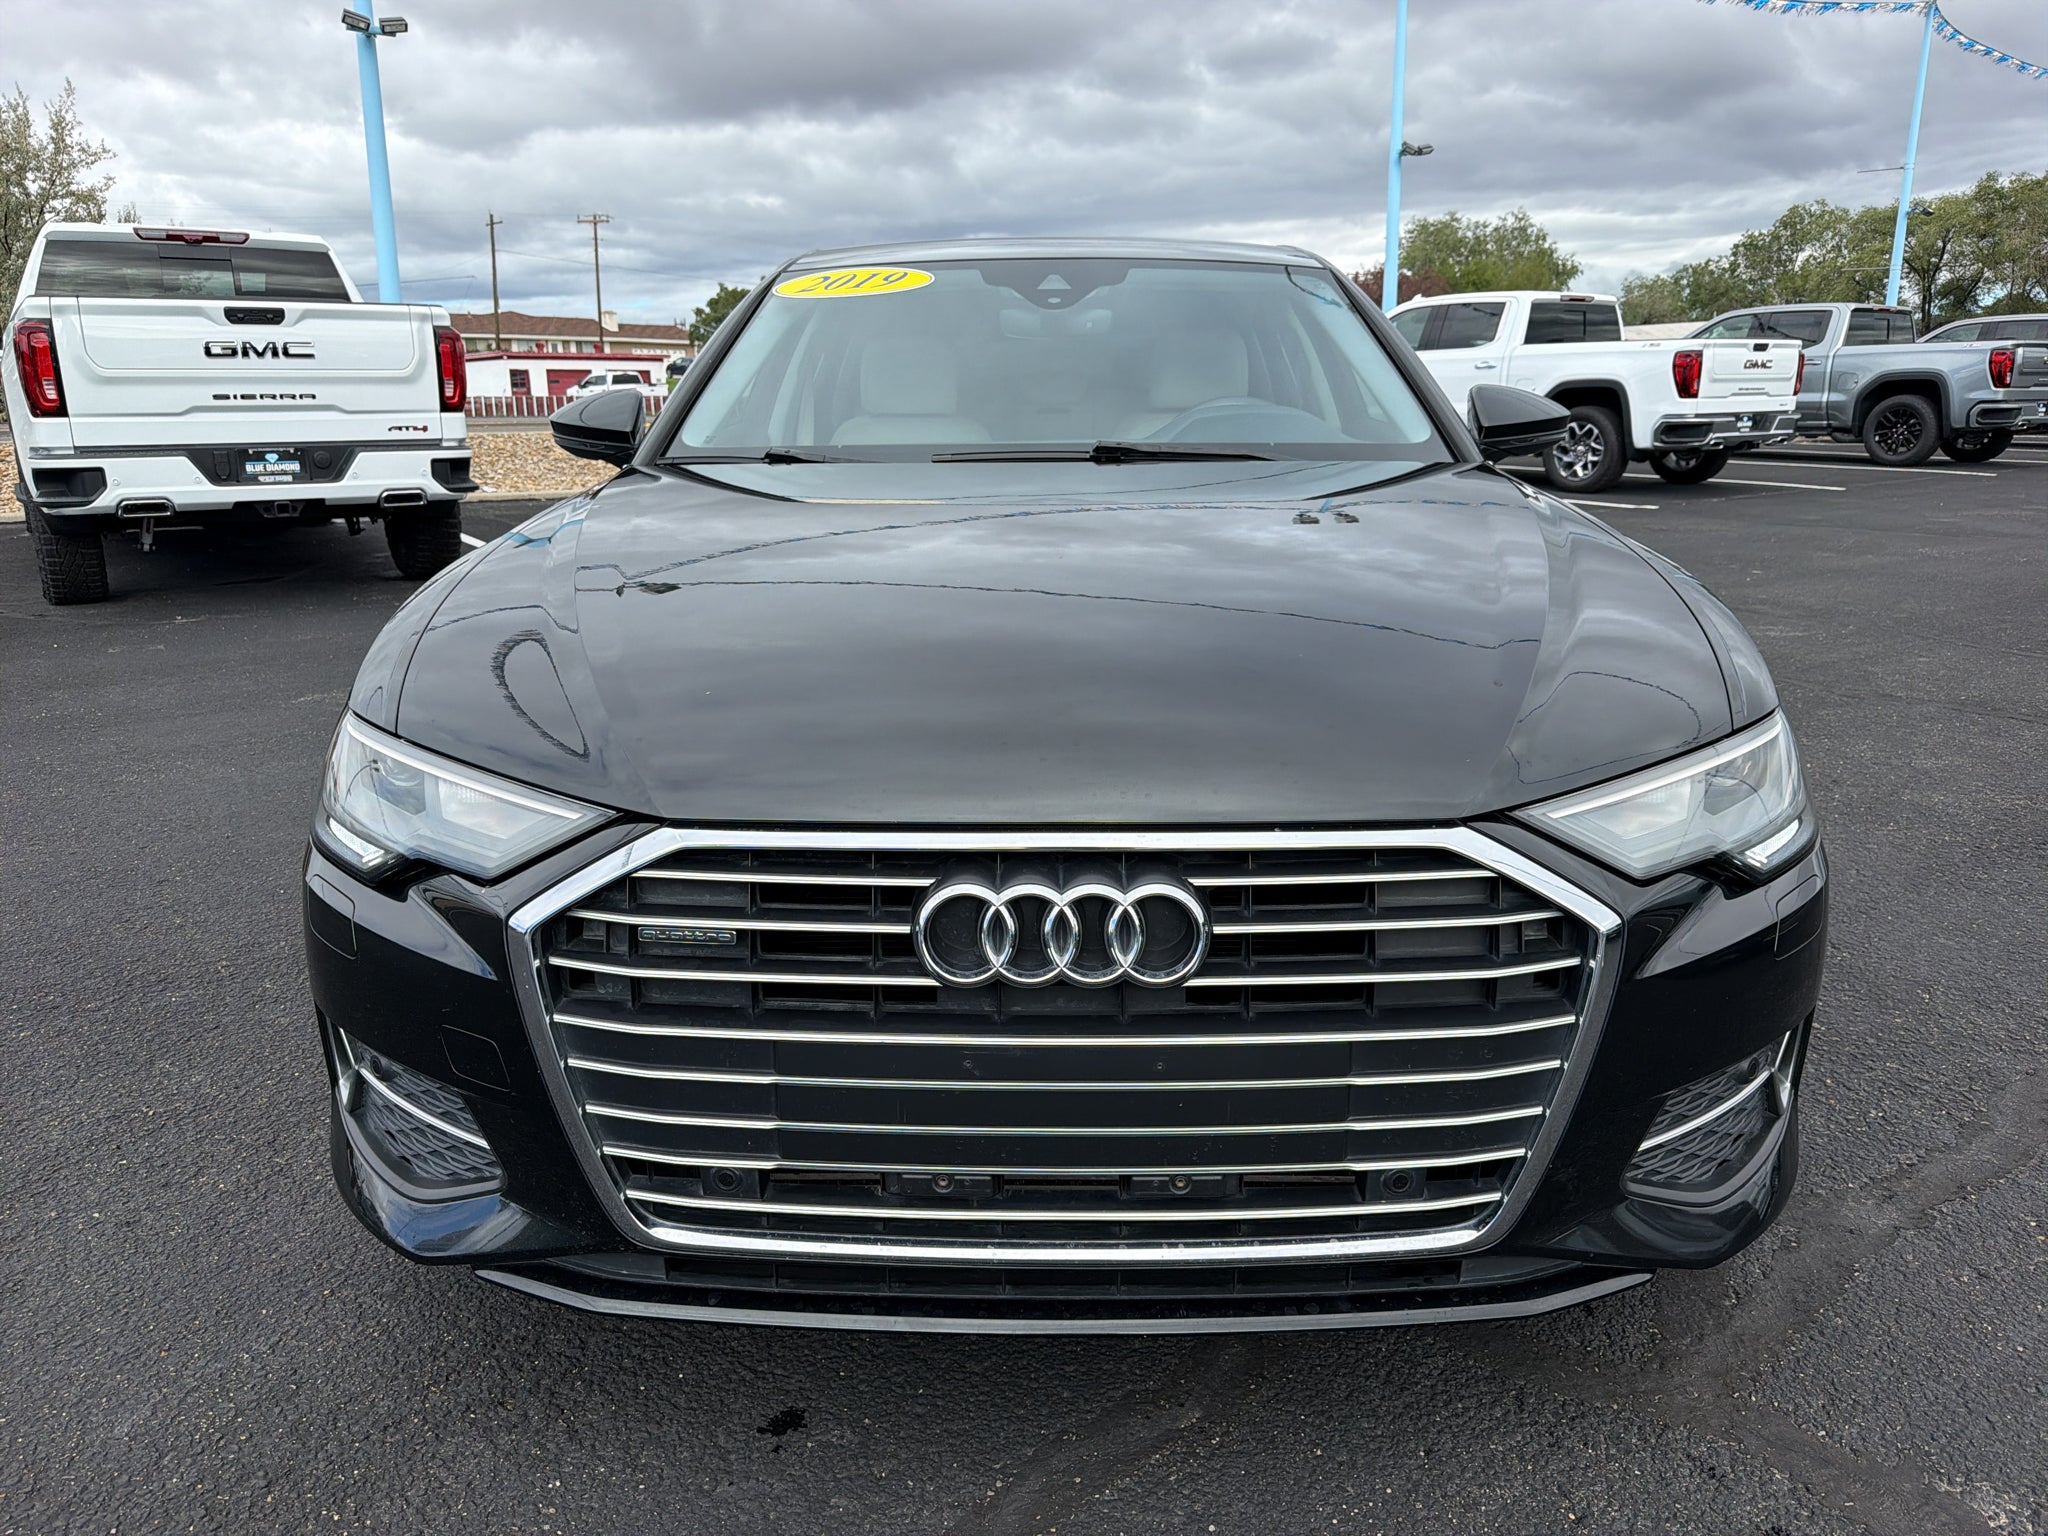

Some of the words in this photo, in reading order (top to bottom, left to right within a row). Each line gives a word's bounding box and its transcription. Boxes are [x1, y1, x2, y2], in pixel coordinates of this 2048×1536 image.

[794, 271, 909, 294] 2019
[203, 340, 315, 359] GMC
[1743, 359, 1773, 369] GMC
[245, 463, 265, 472] BLUE
[266, 462, 300, 471] DIAMOND
[642, 930, 732, 941] quattro
